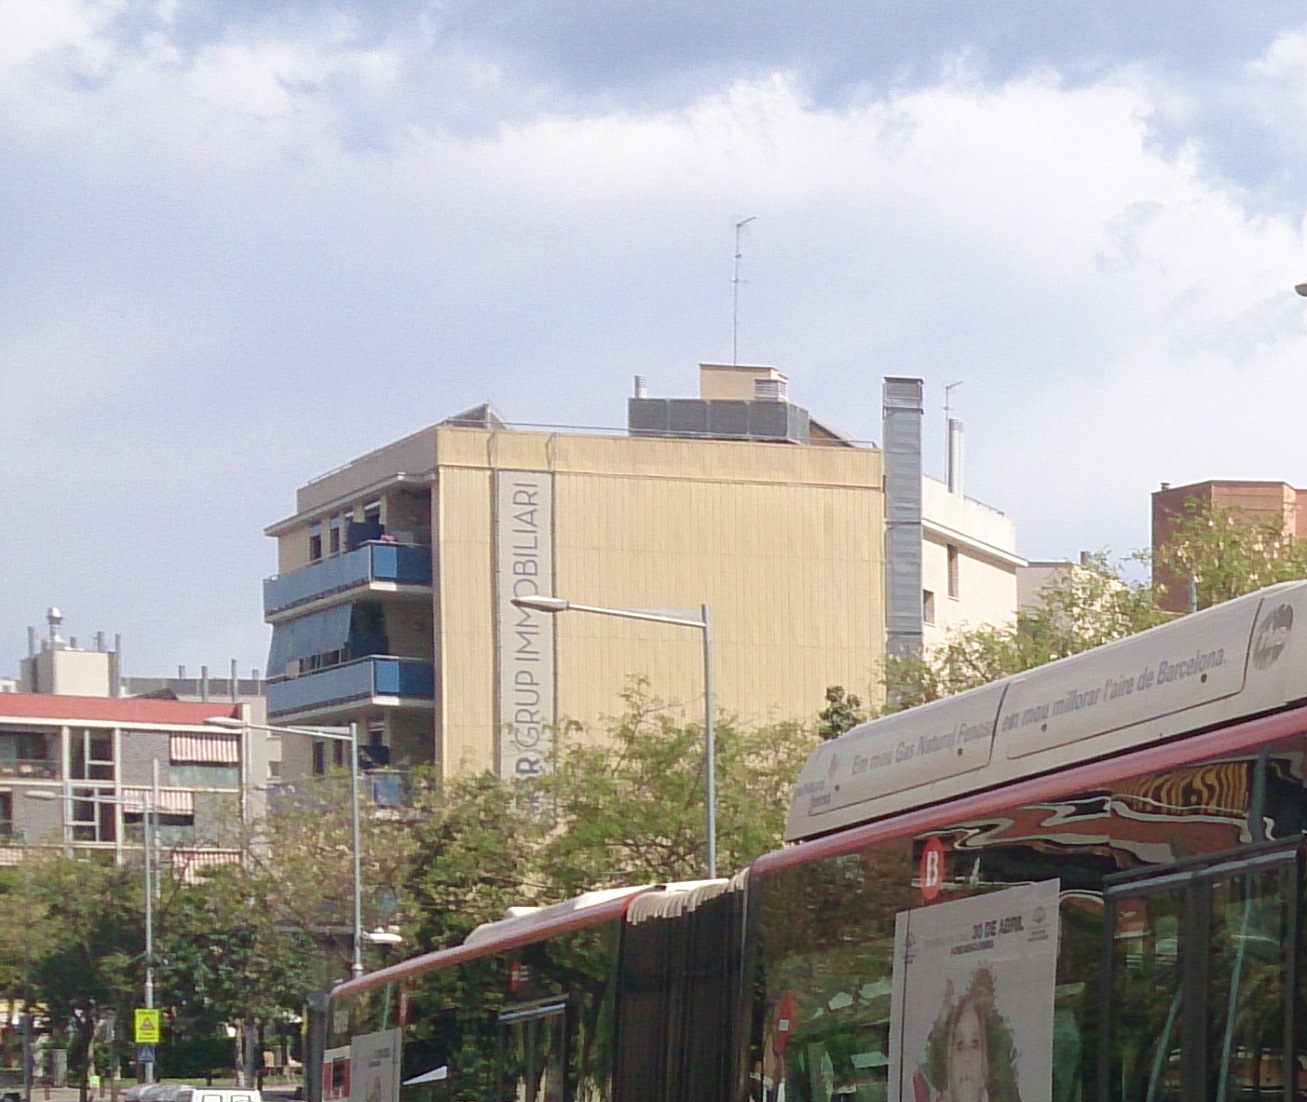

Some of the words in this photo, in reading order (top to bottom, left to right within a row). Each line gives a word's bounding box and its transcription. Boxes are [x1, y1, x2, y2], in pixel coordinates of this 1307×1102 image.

[895, 741, 915, 763] Gas
[917, 722, 957, 756] Natural
[1052, 687, 1102, 717] millorar
[1104, 678, 1132, 702] l'aire
[1137, 667, 1154, 690] de
[926, 850, 939, 887] B
[972, 922, 983, 939] 30
[985, 919, 997, 938] DE
[999, 915, 1024, 935] ABRIL
